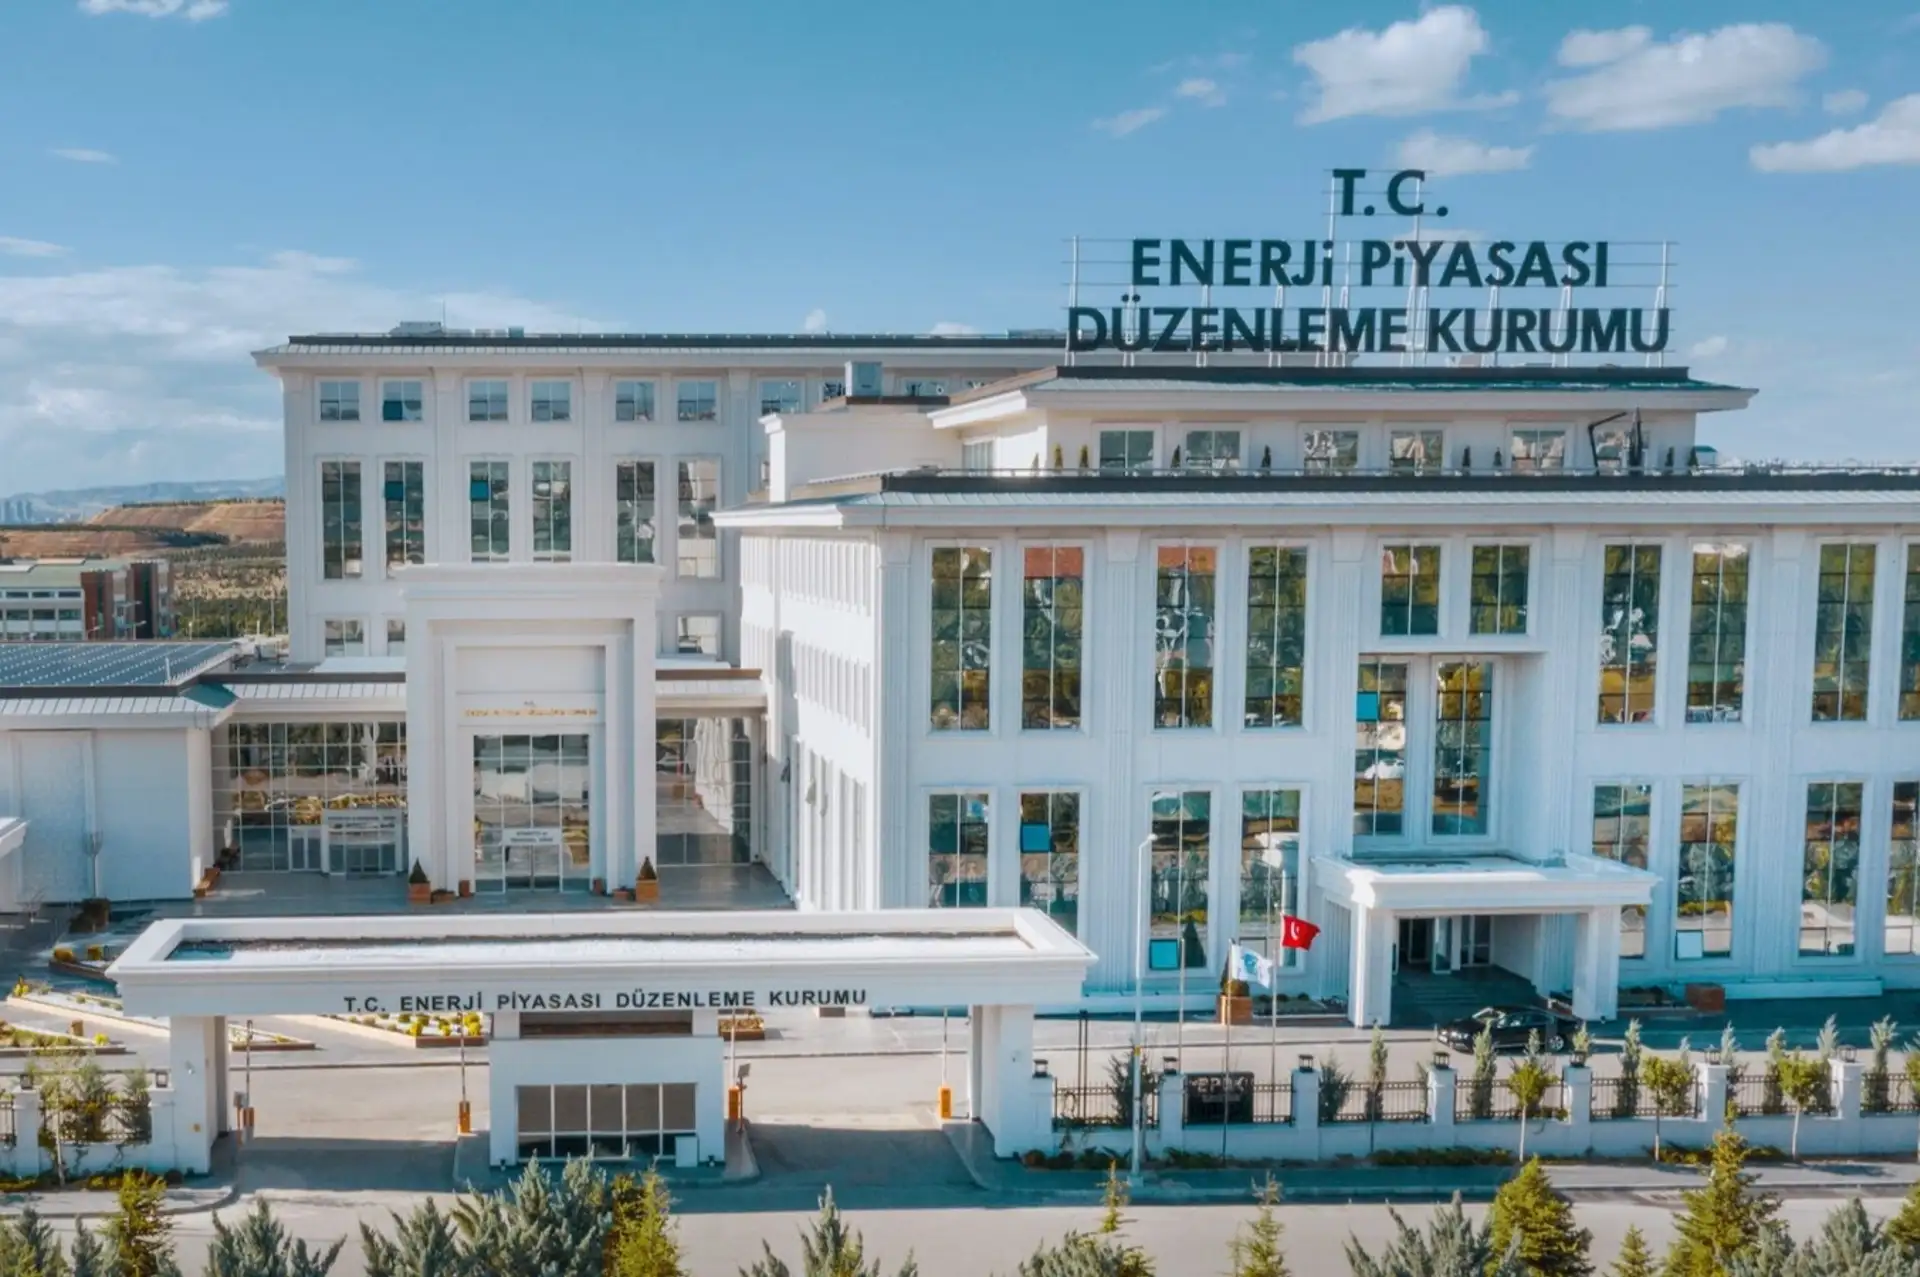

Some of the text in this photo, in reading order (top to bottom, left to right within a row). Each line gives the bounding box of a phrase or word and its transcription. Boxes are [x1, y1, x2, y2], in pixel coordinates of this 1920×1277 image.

[1332, 168, 1449, 217] T.C.
[1067, 293, 1670, 353] DÜZENLEME KURUMU
[344, 989, 867, 1012] T.C. ENERJİ PİYASASI DÜZENLEME KURUMU
